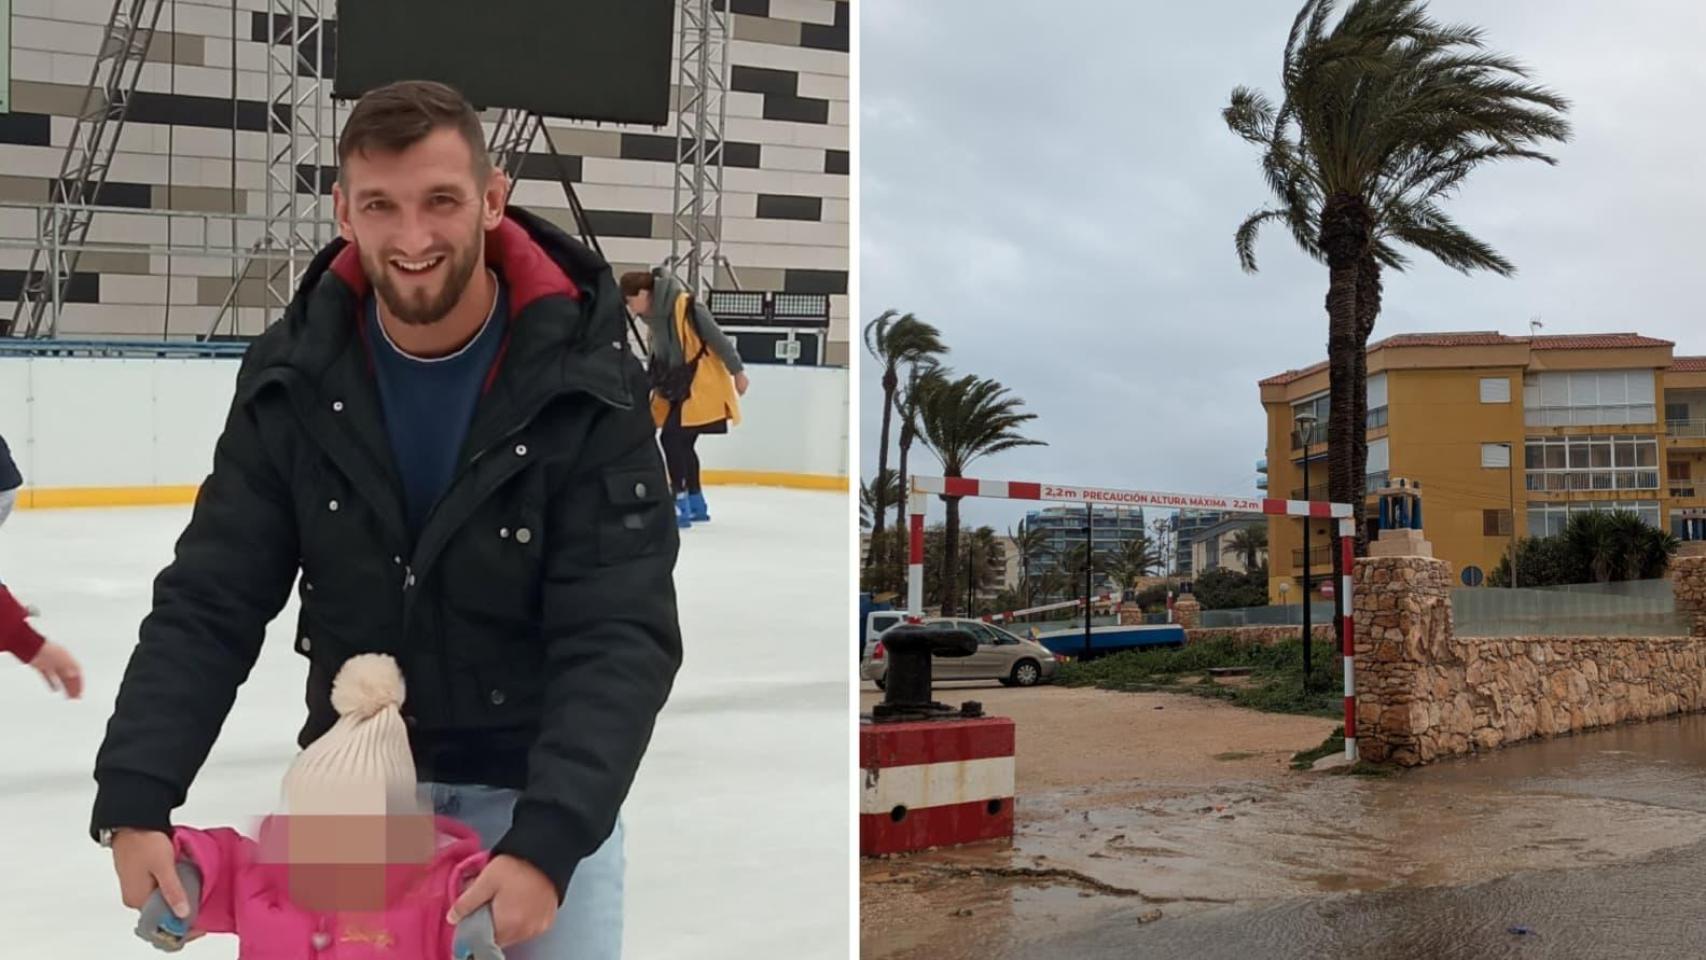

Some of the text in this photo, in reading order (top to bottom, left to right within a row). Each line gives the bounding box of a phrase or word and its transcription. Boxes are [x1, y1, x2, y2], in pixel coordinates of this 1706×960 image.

[1082, 490, 1147, 503] PRECAUCIÓN
[1150, 495, 1188, 505] ALTURA
[1189, 497, 1227, 508] MÁXIMA
